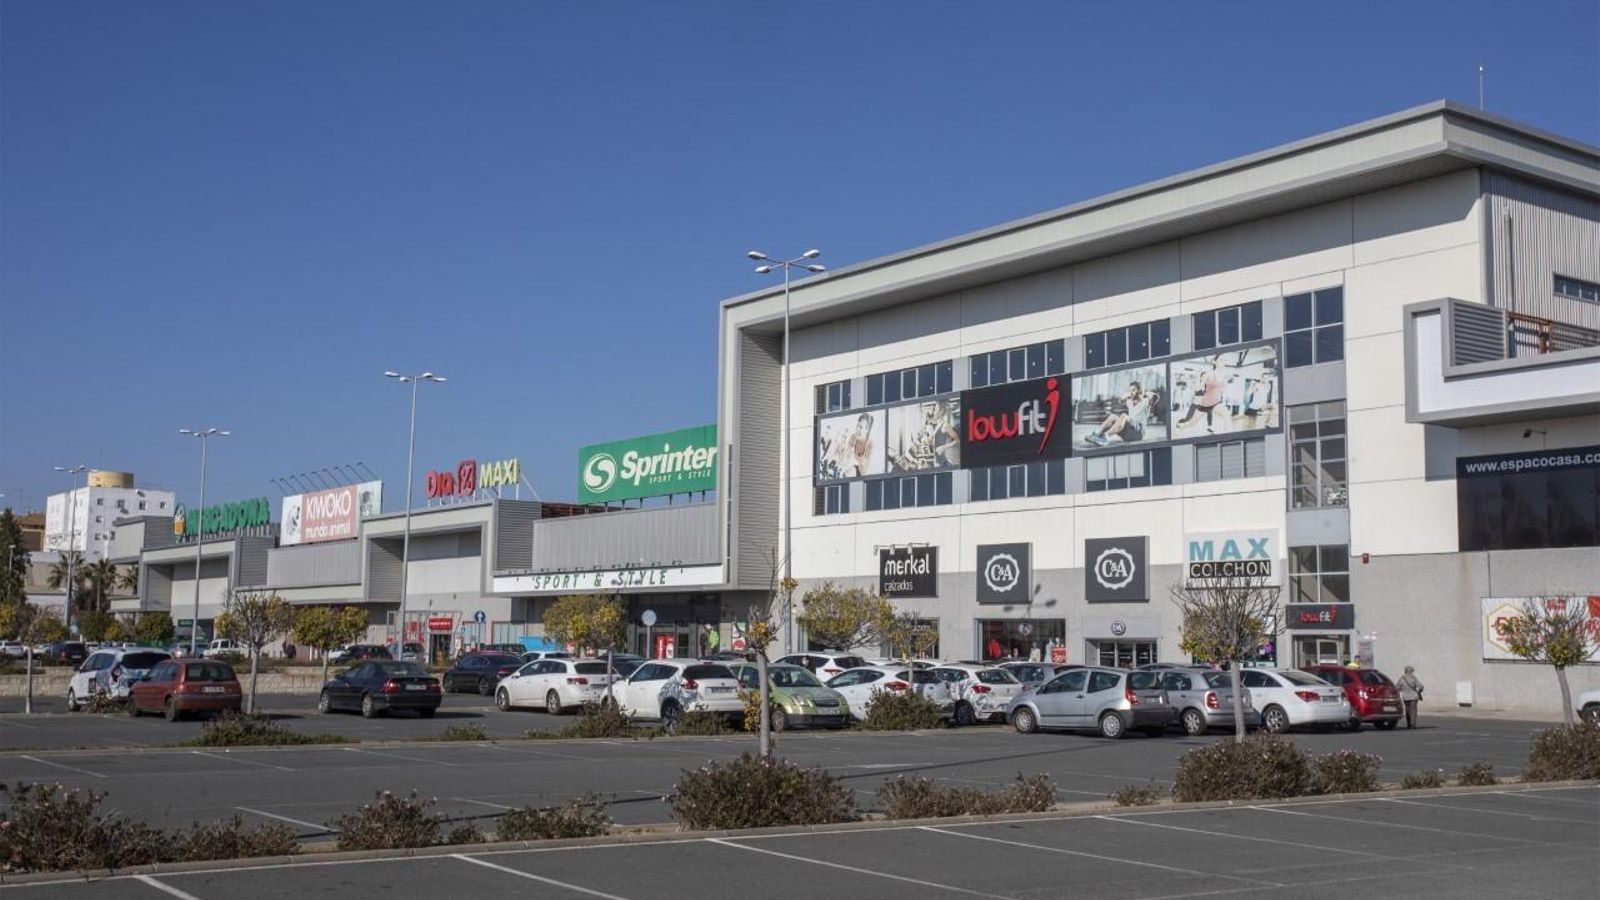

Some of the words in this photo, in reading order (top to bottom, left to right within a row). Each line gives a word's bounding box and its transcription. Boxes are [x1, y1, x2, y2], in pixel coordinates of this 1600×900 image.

[967, 398, 1048, 442] lowfit
[480, 459, 519, 489] MAXI
[620, 443, 718, 486] Sprinter
[305, 490, 352, 521] KIWOKO
[305, 523, 328, 538] mundo
[1189, 537, 1271, 561] MAX
[884, 553, 931, 576] merkal
[990, 563, 1014, 582] C&A
[1100, 558, 1129, 579] C&A
[1190, 561, 1270, 578] COLCHON
[594, 572, 603, 588] &
[616, 568, 669, 587] STYLE
[884, 580, 914, 592] calzados
